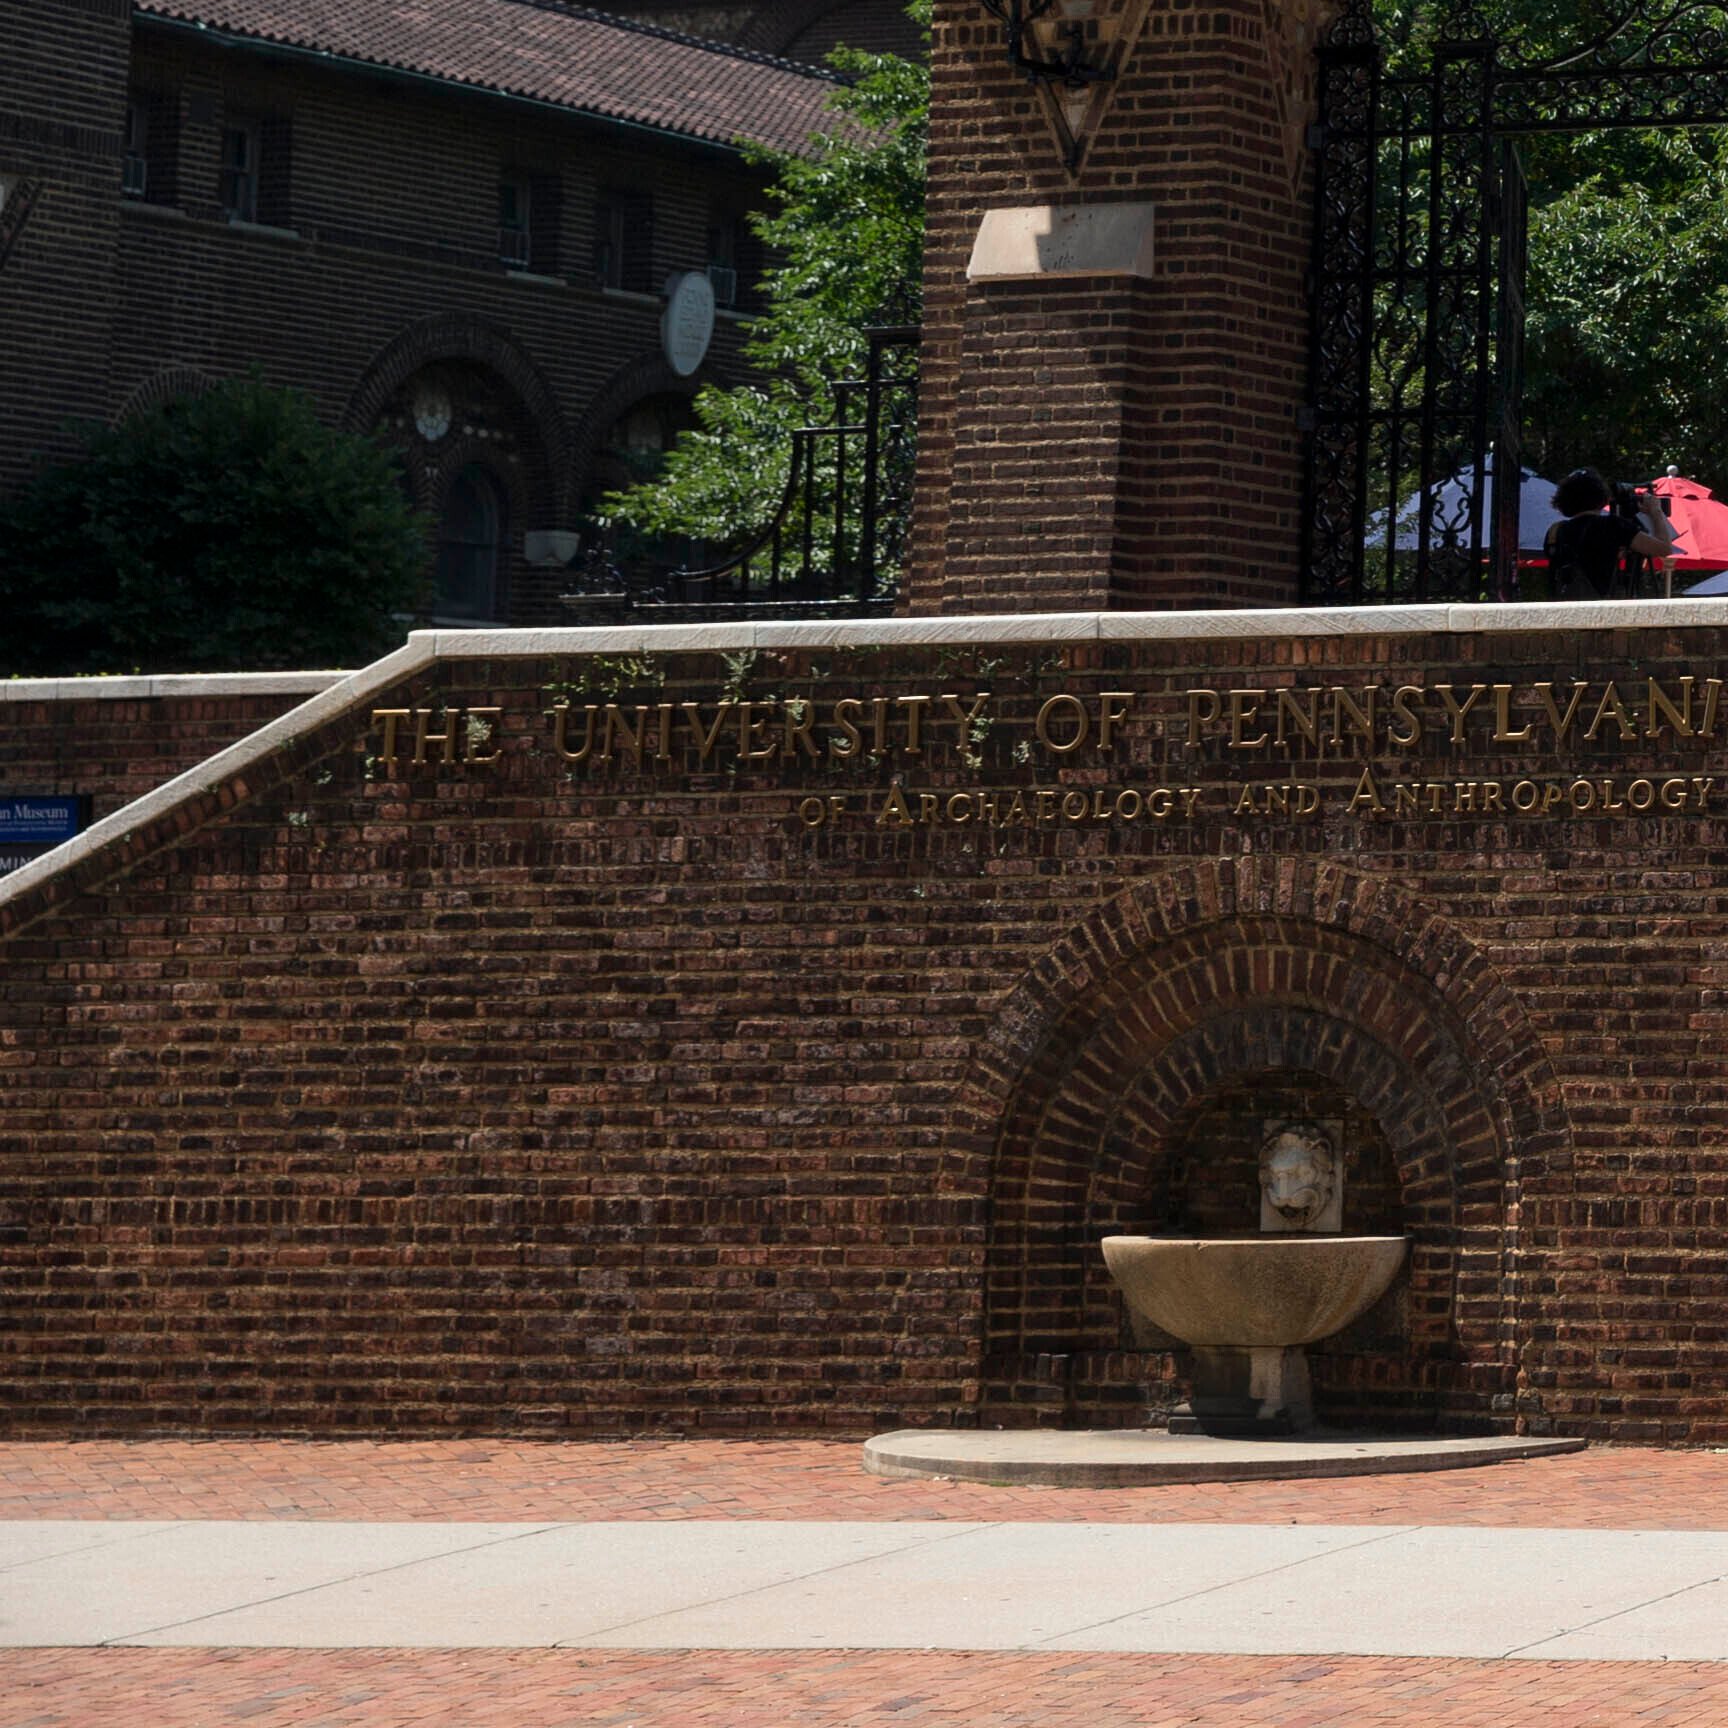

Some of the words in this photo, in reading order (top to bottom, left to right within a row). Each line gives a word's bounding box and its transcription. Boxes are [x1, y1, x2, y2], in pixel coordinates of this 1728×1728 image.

[371, 706, 503, 765] THE
[553, 692, 991, 762] UNIVERSITY
[1035, 691, 1136, 754] OF
[801, 794, 846, 828] OF
[875, 781, 1201, 826] ARCHAEOLOGY
[1233, 784, 1322, 817] AND
[1346, 767, 1716, 815] ANTHROPOLOGY
